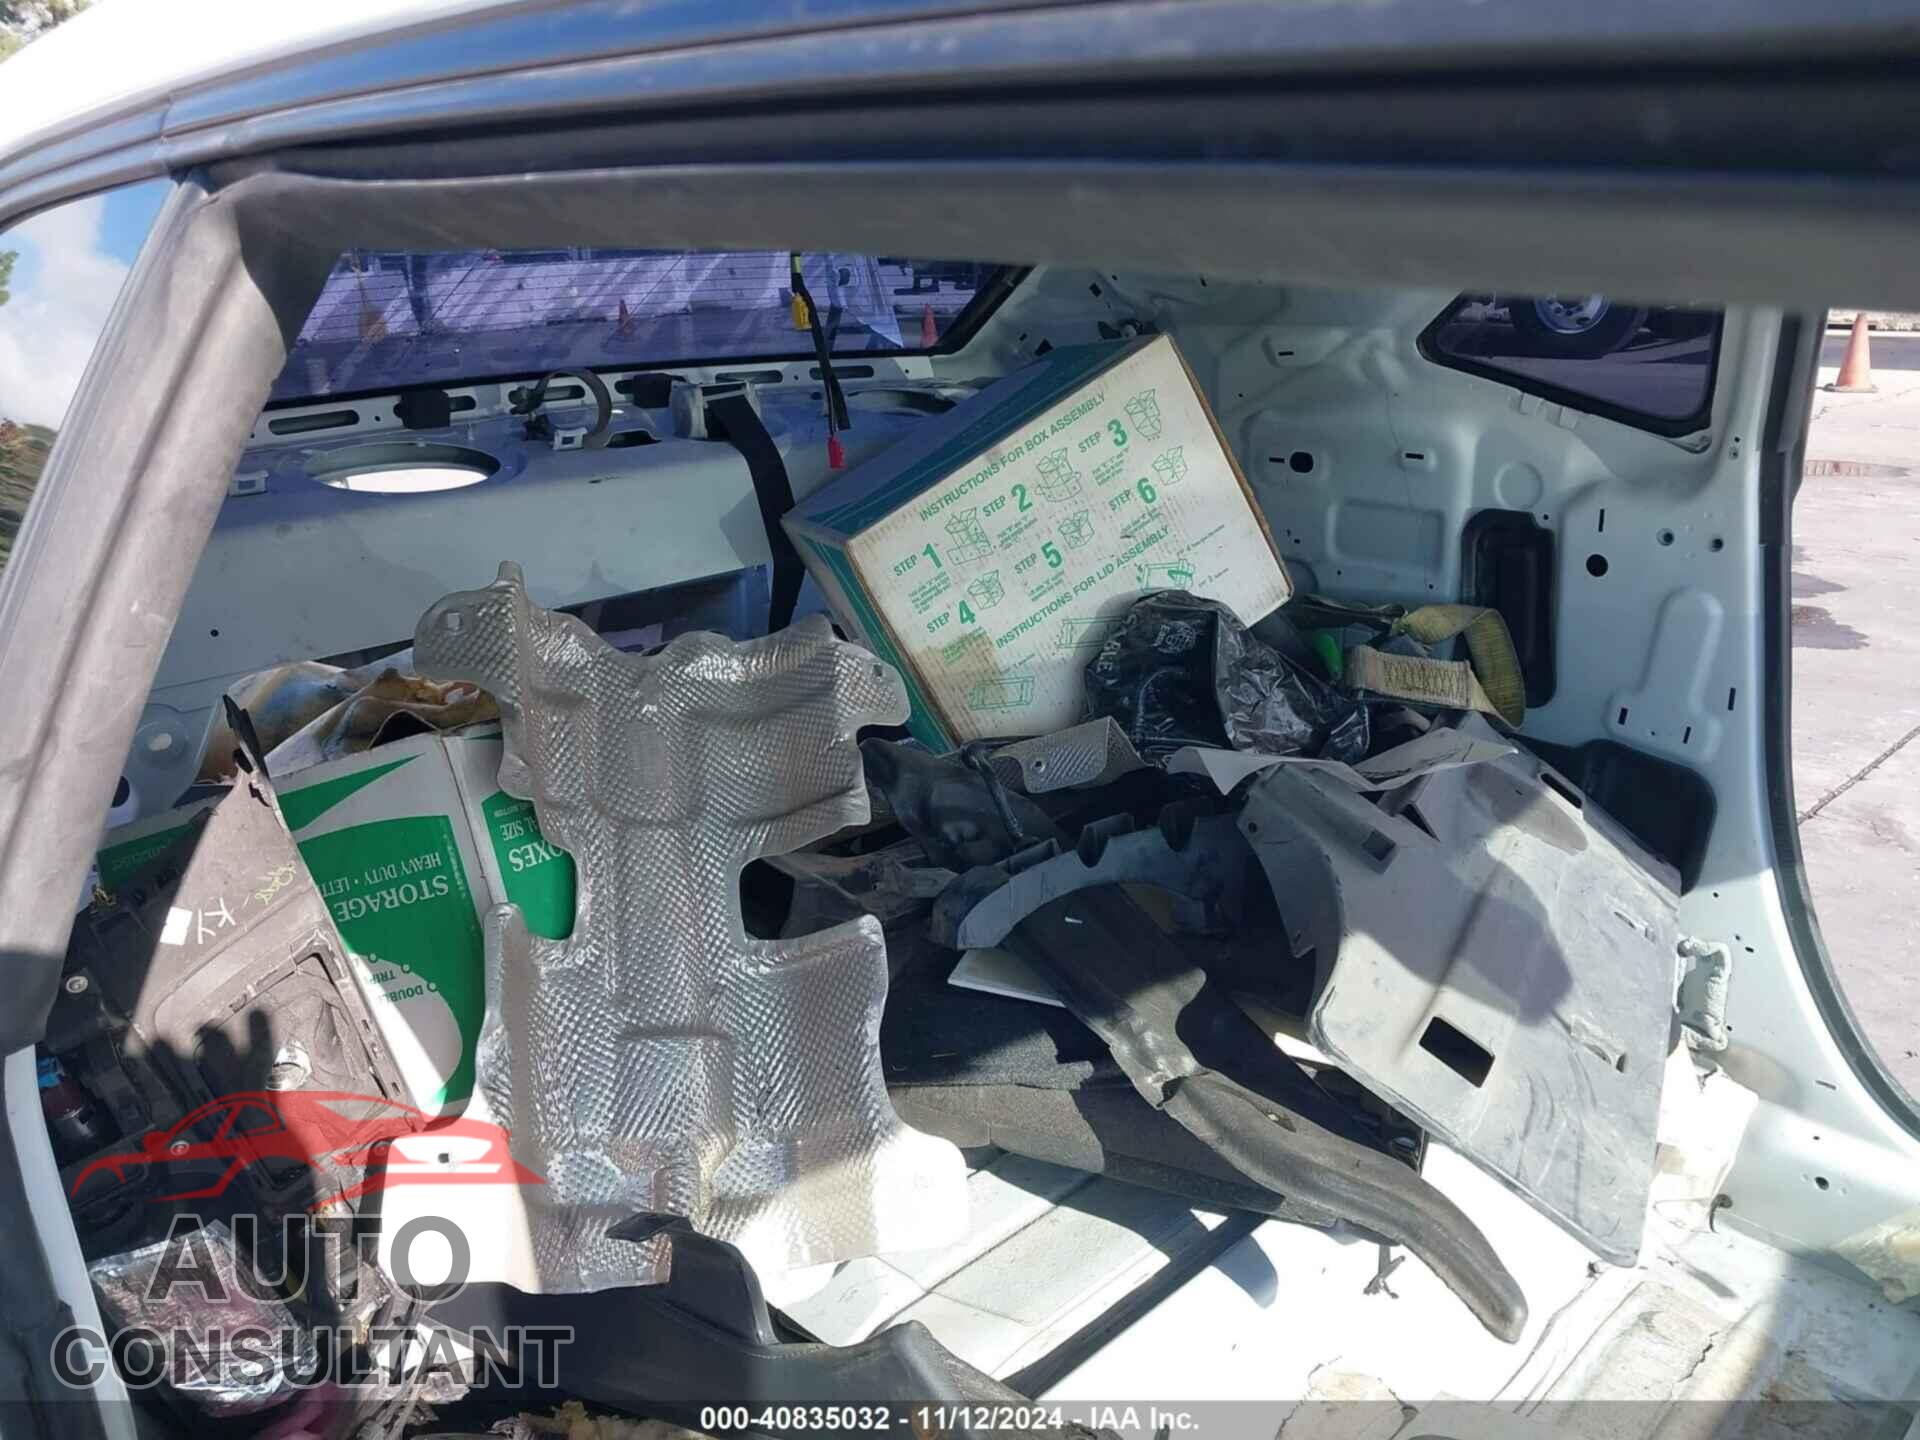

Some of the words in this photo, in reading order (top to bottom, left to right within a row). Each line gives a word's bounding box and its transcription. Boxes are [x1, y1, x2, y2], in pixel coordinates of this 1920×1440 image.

[1078, 431, 1102, 454] STEP
[1107, 418, 1128, 447] 3
[919, 461, 1001, 522] INSTRUCTIONS
[1000, 446, 1025, 468] FOR
[1024, 429, 1049, 453] BOX
[1050, 392, 1105, 436] ASSEMBLY
[982, 495, 1006, 518] STEP
[1011, 483, 1033, 513] 2
[1109, 488, 1132, 512] STEP
[1136, 477, 1157, 504] 6
[893, 554, 918, 577] STEP
[922, 543, 942, 569] 1
[1014, 553, 1038, 575] STEP
[1041, 539, 1063, 569] 5
[995, 591, 1073, 649] INSTRUCTIONS
[1073, 575, 1096, 597] FOR
[1096, 562, 1115, 581] LID
[1116, 525, 1169, 568] ASSEMBLY
[926, 611, 951, 633] STEP
[958, 599, 976, 625] 4
[499, 820, 525, 841] SIZE
[401, 851, 441, 876] HEAVY
[508, 838, 564, 872] OXES
[322, 876, 351, 898] LETT
[364, 863, 398, 886] DUTY
[333, 874, 449, 922] STORAGE
